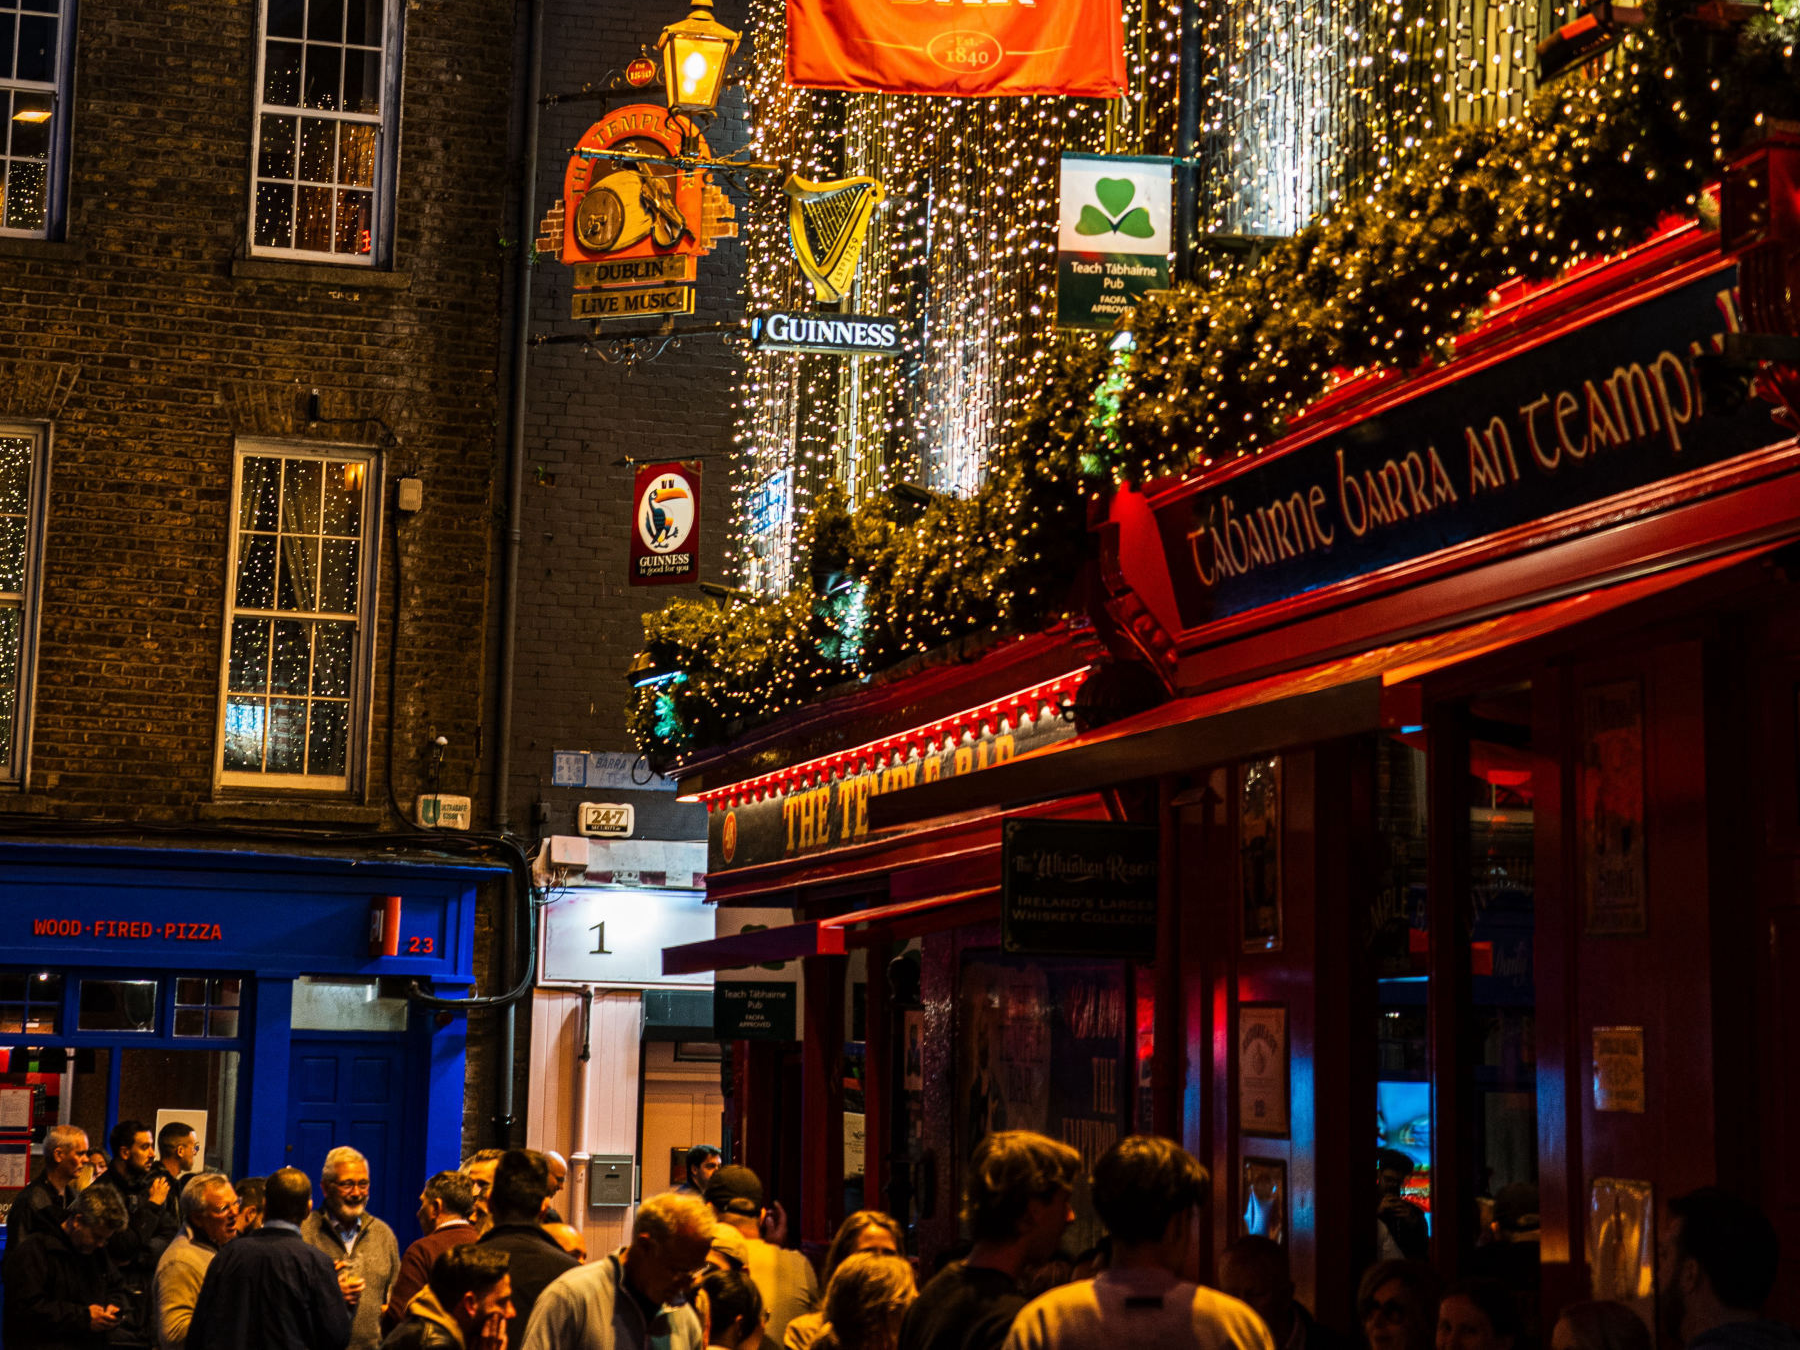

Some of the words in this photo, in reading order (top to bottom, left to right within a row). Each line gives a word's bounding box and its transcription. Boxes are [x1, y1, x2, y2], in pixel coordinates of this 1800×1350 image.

[945, 47, 989, 65] 1840
[596, 261, 664, 280] DUBLIN
[1071, 261, 1102, 274] Teach
[1104, 278, 1124, 289] Pub
[581, 297, 618, 314] LIVE
[625, 292, 676, 311] MUSIC
[766, 313, 896, 347] GUINNESS
[640, 554, 689, 566] GUINNESS
[647, 565, 664, 576] good
[676, 565, 689, 573] you
[783, 786, 830, 851] THE
[408, 936, 434, 954] 23
[588, 920, 613, 955] 1
